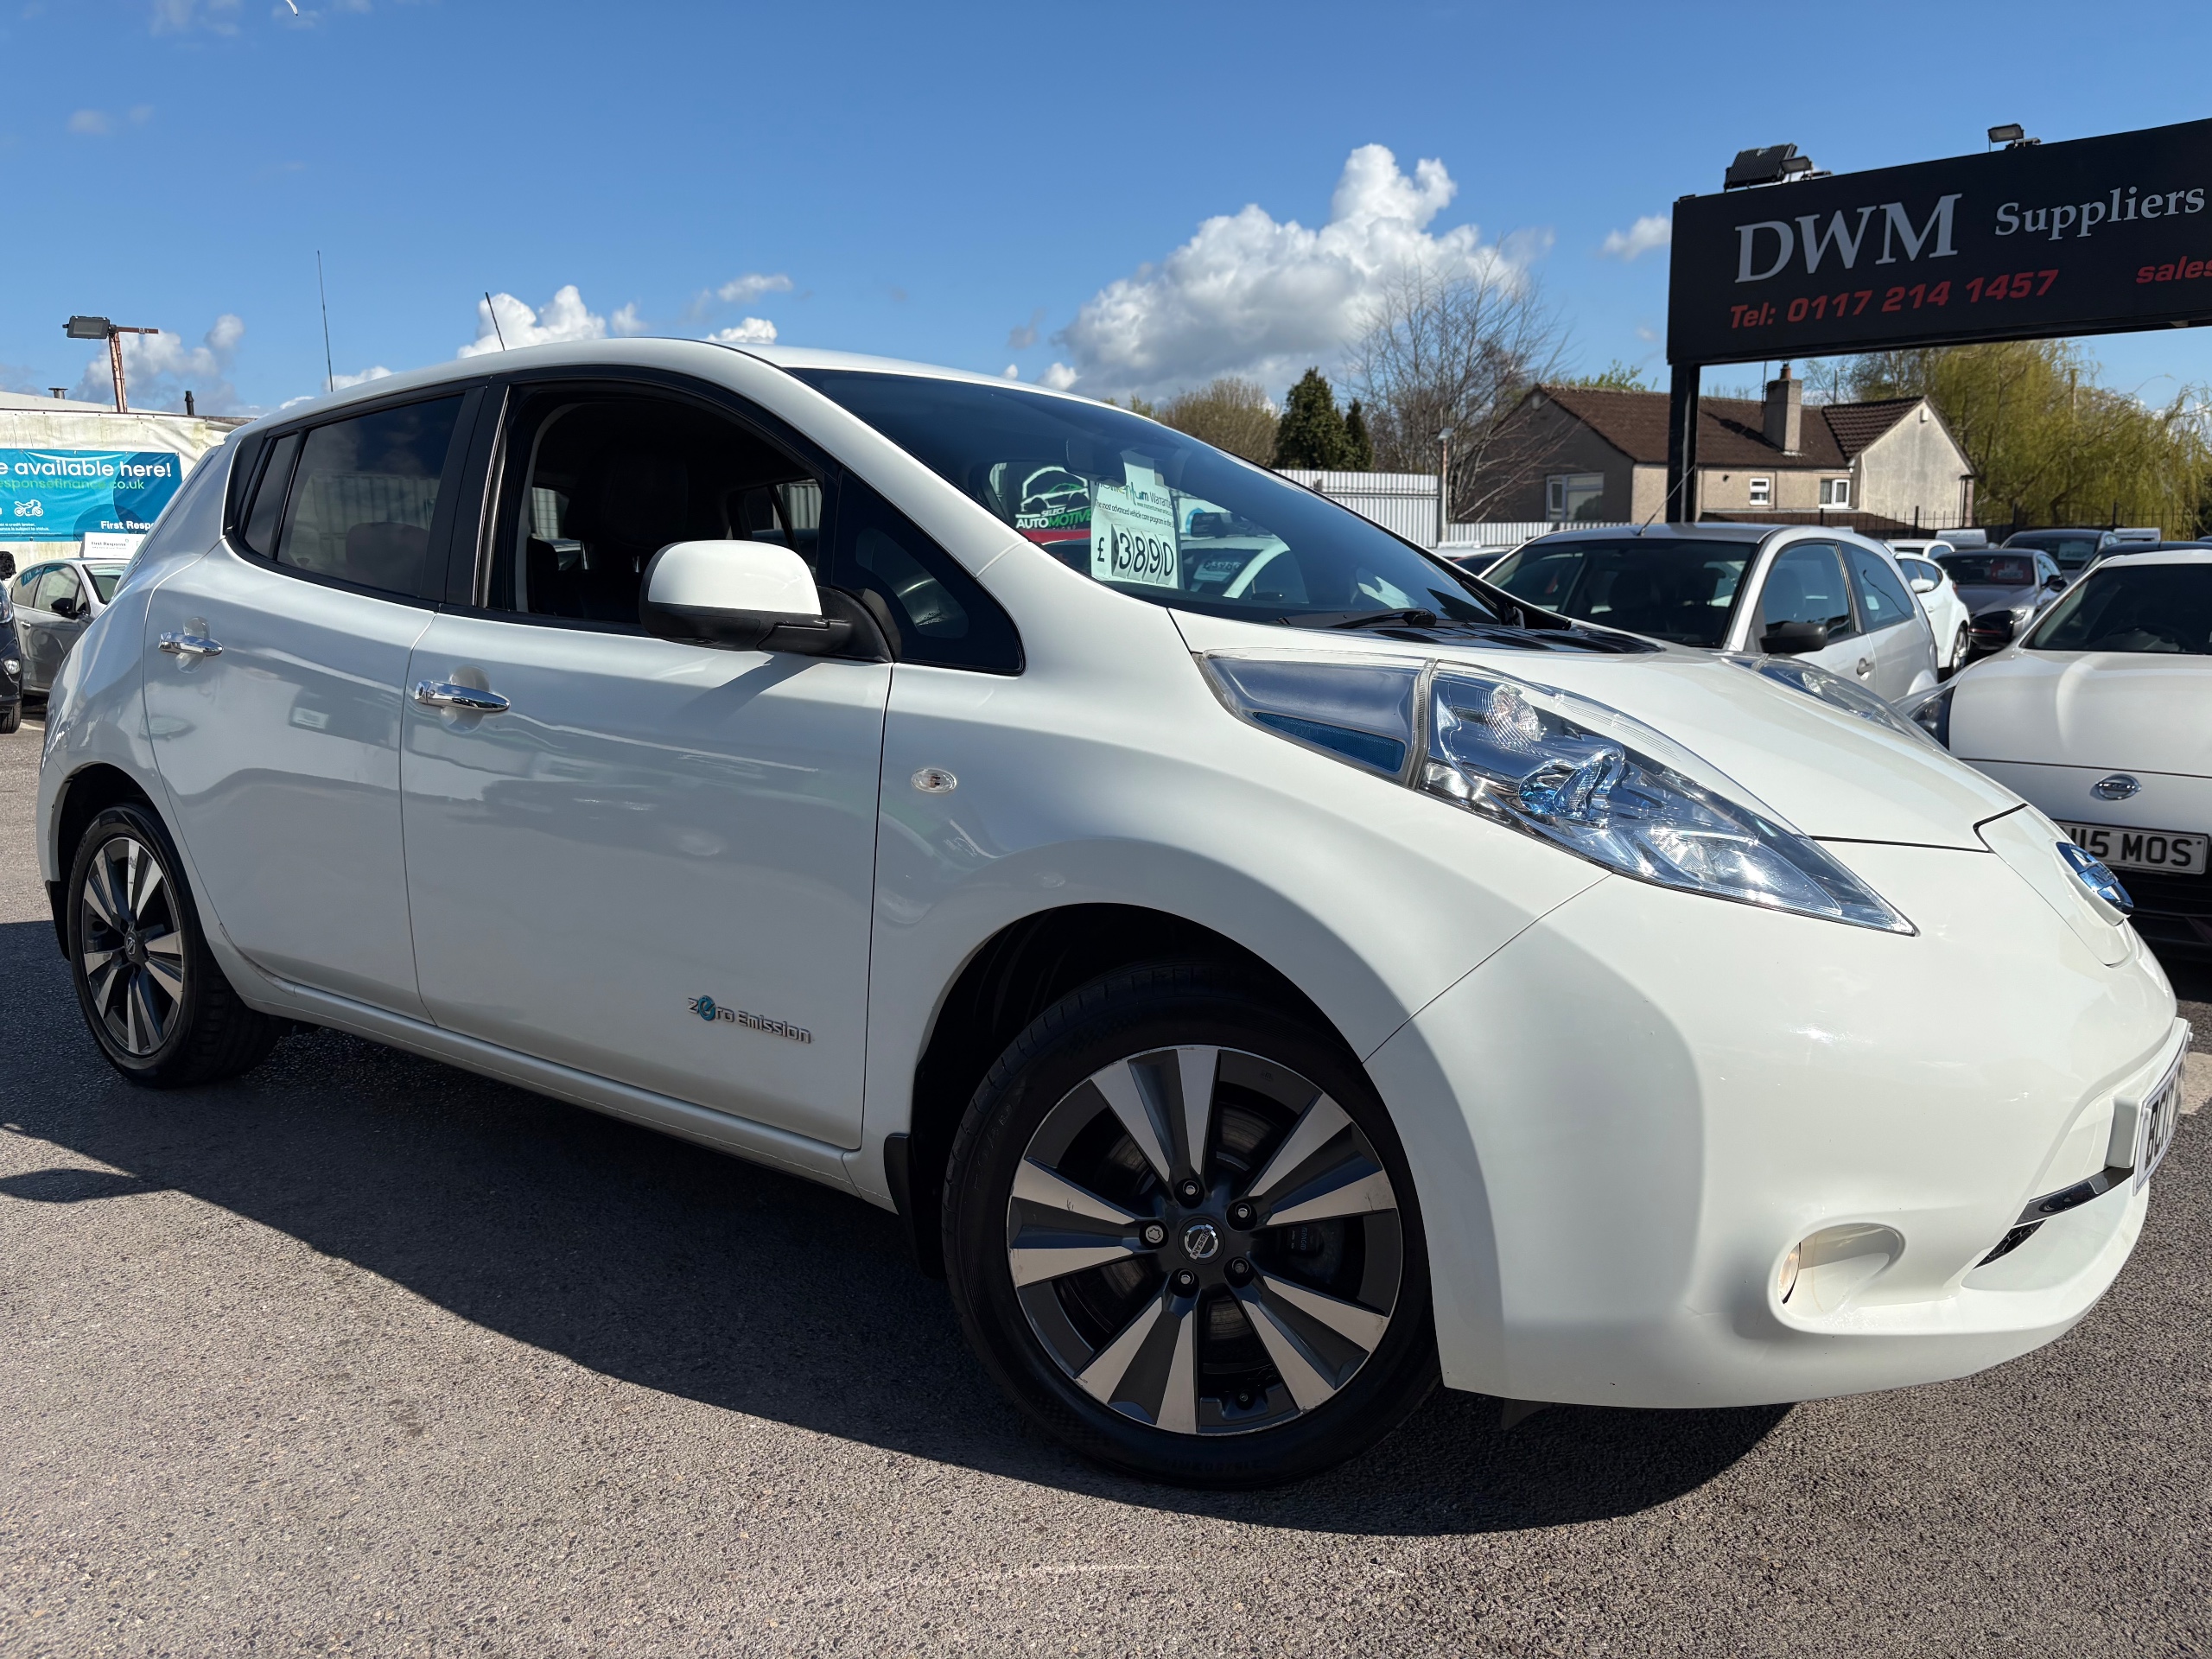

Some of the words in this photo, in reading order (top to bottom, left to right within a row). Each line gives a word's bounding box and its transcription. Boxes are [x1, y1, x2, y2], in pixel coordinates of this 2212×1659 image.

[1734, 193, 1963, 283] DWM
[1994, 186, 2205, 241] Suppliers
[1730, 302, 1776, 329] Tel:
[1787, 289, 1873, 323] 0117
[1881, 281, 1951, 313] 214
[1965, 269, 2059, 303] 1457
[14, 459, 114, 477] available
[119, 461, 171, 478] here!
[100, 520, 124, 530] First
[1041, 507, 1067, 518] SELECT
[1096, 537, 1105, 563] £
[1119, 532, 1174, 576] 3890
[2120, 833, 2193, 867] MOS
[736, 1009, 812, 1044] Emission
[1192, 1227, 1211, 1257] NISSAN
